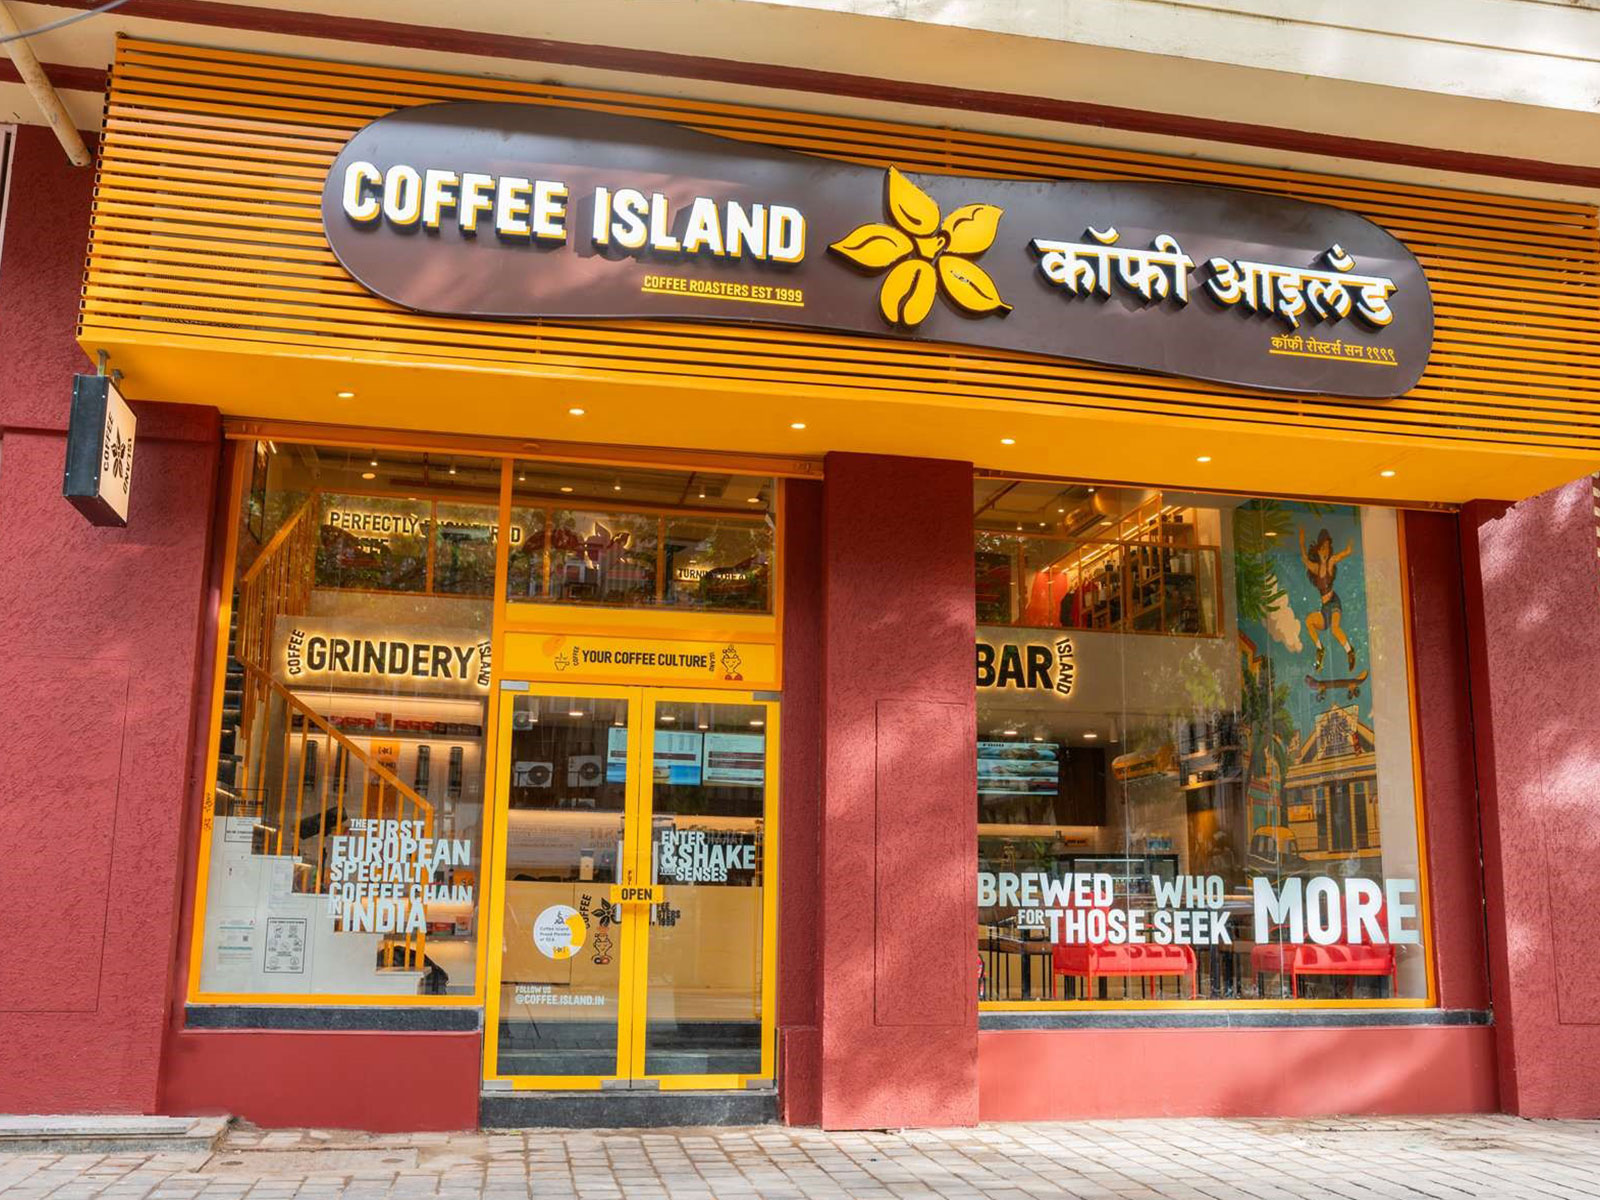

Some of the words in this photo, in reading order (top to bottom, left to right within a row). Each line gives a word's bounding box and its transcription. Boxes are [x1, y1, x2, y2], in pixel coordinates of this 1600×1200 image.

[343, 161, 569, 241] COFFEE
[592, 187, 807, 263] ISLAND
[1031, 225, 1195, 305] कॉफी
[644, 275, 687, 291] COFFEE
[689, 279, 749, 297] ROASTERS
[751, 286, 773, 299] EST
[775, 288, 803, 302] 1999
[1271, 334, 1303, 350] कॉफी
[1344, 344, 1363, 357] सन
[1366, 346, 1397, 362] १९९९
[104, 412, 113, 471] COFFEE
[123, 438, 132, 494] ISLAND
[329, 511, 419, 535] PERFECTLY
[287, 629, 305, 675] COFFEE
[306, 636, 476, 679] GRINDERY
[477, 641, 492, 686] ISLAND
[582, 650, 611, 664] YOUR
[614, 651, 656, 666] COFFEE
[658, 653, 707, 668] CULTURE
[975, 643, 1054, 689] BAR
[1056, 638, 1074, 694] ISLAND
[350, 818, 367, 829] THE
[367, 819, 425, 841] FIRST
[661, 831, 705, 846] ENTER
[331, 836, 472, 866] EUROPEAN
[329, 861, 435, 884] SPECIALTY
[676, 867, 728, 883] SENSES
[978, 872, 1114, 907] BREWED
[328, 882, 405, 904] COFFEE
[409, 884, 473, 905] CHAIN
[621, 888, 653, 901] OPEN
[1152, 875, 1225, 909] WHO
[328, 899, 342, 915] IN
[342, 901, 428, 934] INDIA
[1017, 908, 1044, 925] FOR
[1045, 909, 1145, 945] THOSE
[1253, 876, 1421, 945] MORE
[1153, 911, 1232, 945] SEEK
[515, 985, 541, 994] FOLLOW
